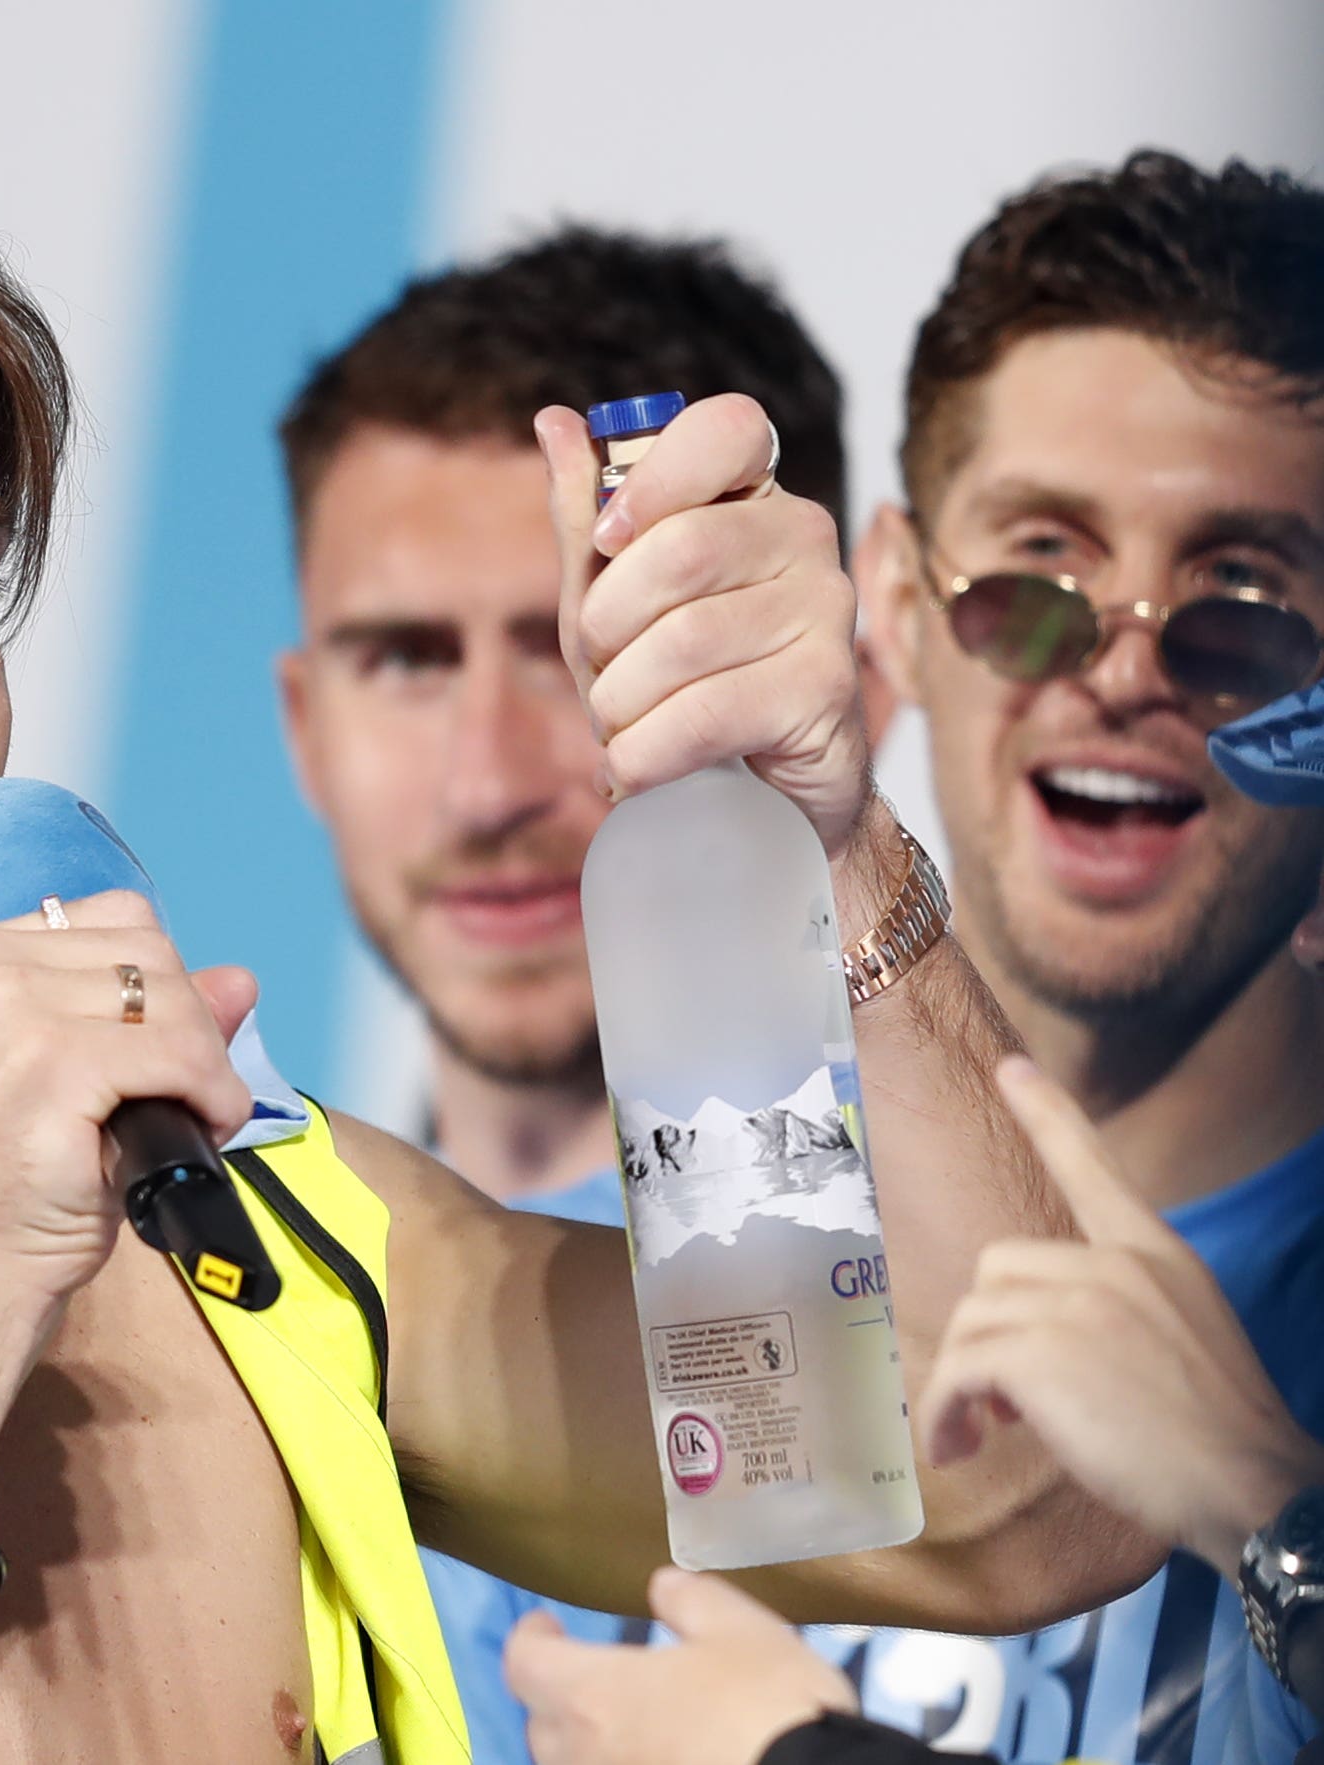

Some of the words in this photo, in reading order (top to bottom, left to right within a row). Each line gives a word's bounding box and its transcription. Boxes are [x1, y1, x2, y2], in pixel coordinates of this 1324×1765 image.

[831, 1254, 890, 1299] GRE
[672, 1366, 749, 1383] drinkaware.co.uk
[674, 1430, 707, 1456] UK
[742, 1451, 766, 1468] 700
[771, 1448, 787, 1464] ml
[742, 1468, 770, 1485] 40%
[773, 1464, 793, 1481] vol
